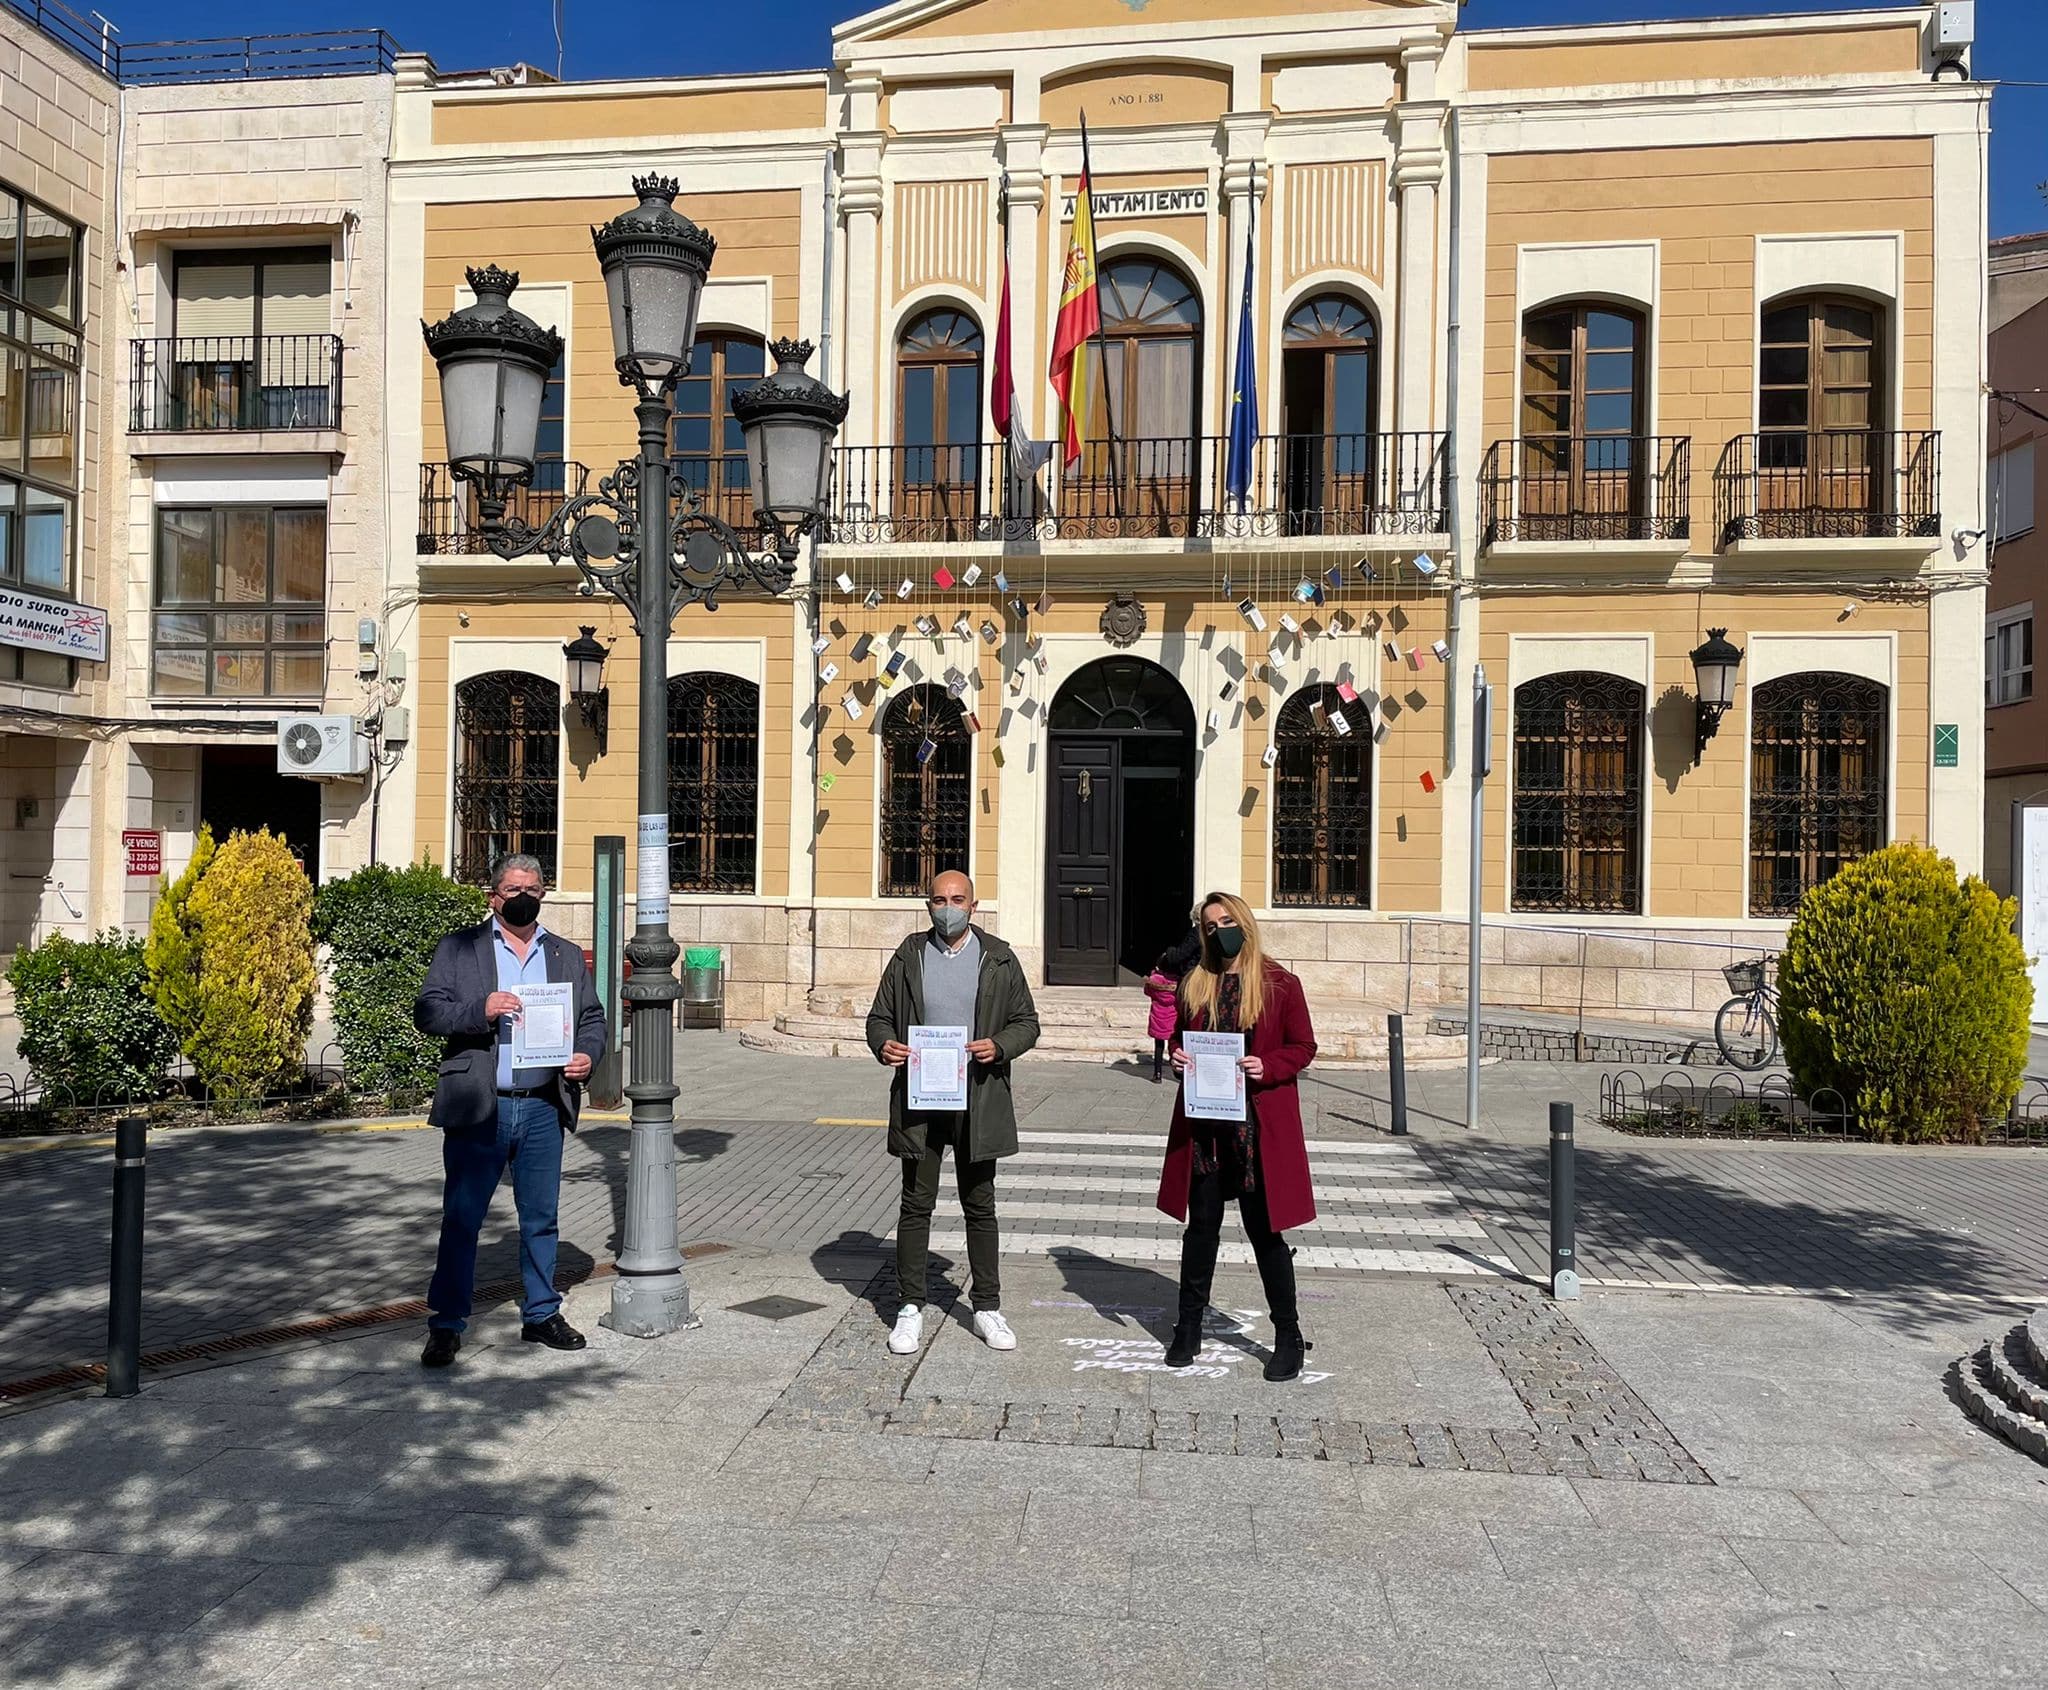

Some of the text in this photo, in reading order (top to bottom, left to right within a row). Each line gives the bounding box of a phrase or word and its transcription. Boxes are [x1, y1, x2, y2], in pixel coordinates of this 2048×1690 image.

[1064, 190, 1207, 216] AUNTAMIENTO
[27, 601, 70, 617] SURCO
[0, 614, 65, 636] LA MANCHA
[70, 633, 87, 643] tv
[69, 642, 99, 652] Mancha
[126, 838, 158, 848] SE VENDE
